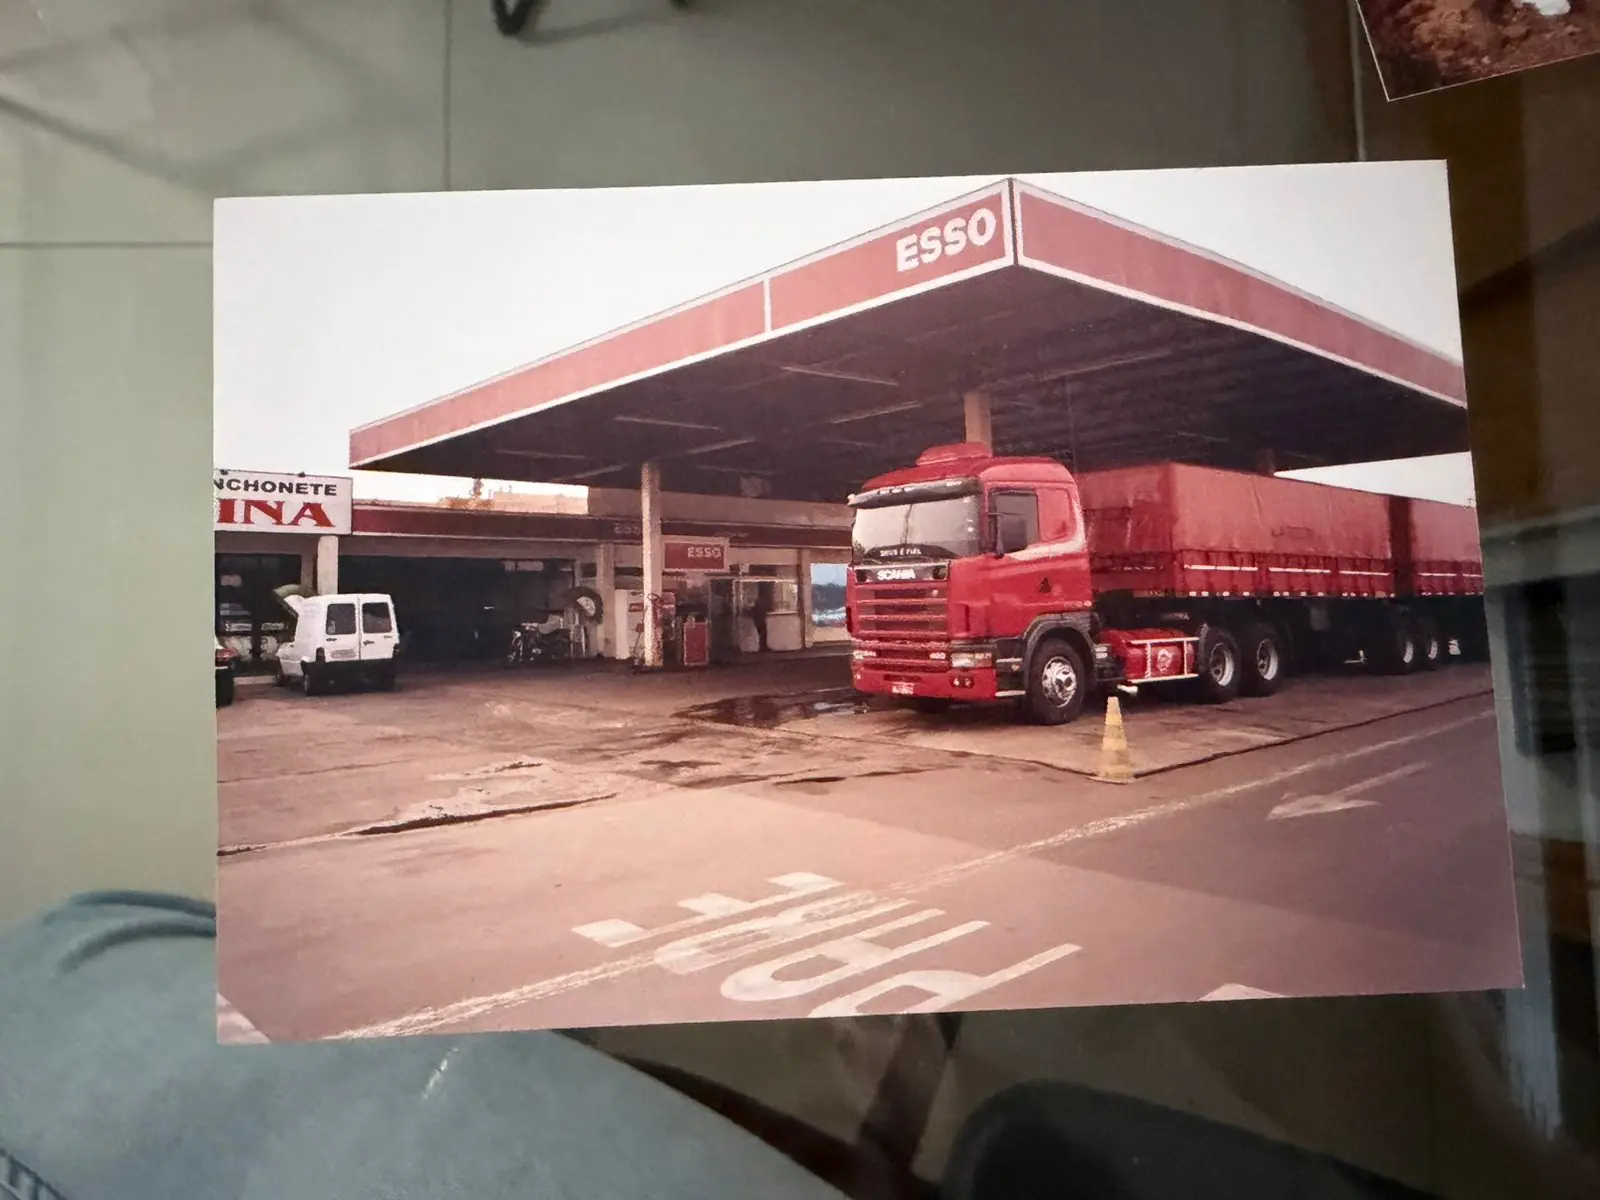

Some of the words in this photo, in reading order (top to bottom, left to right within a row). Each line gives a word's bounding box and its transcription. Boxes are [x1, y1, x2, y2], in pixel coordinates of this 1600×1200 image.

[896, 208, 996, 272] ESSO
[217, 498, 335, 527] INA
[687, 547, 722, 558] ESSO
[877, 568, 916, 580] SCANIA
